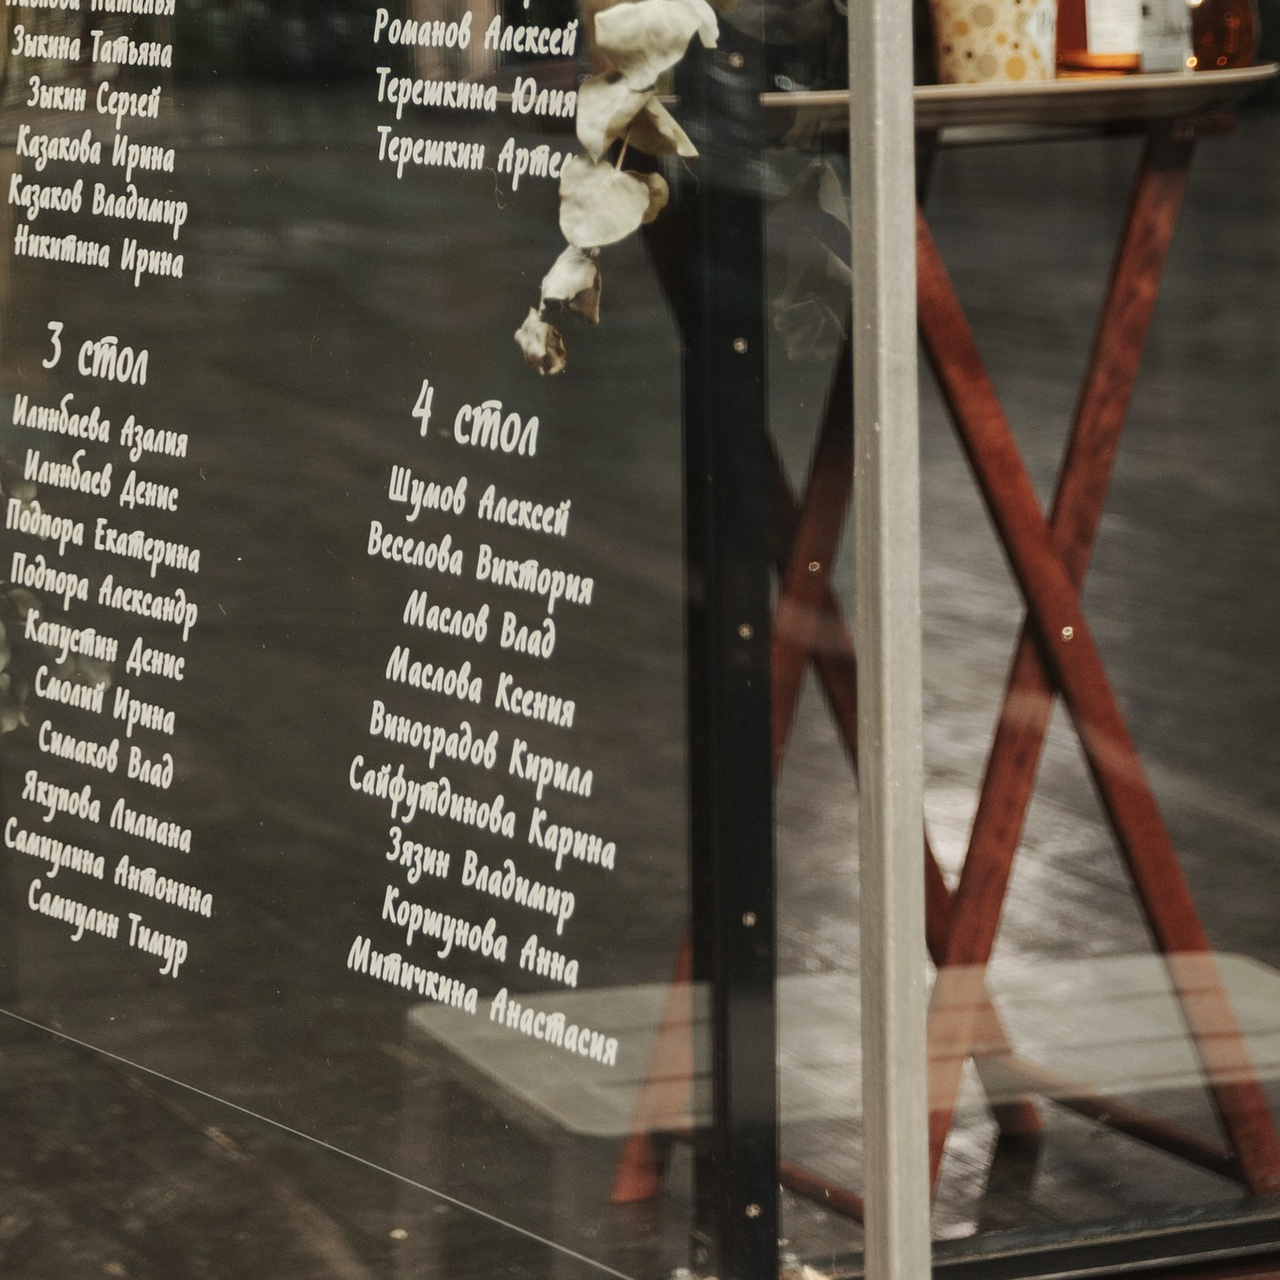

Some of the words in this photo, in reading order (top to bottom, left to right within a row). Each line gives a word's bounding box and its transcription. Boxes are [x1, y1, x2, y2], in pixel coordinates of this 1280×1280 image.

[12, 24, 81, 61] Зыкина
[91, 30, 172, 68] Татьяна
[374, 7, 472, 49] Романов
[484, 14, 578, 56] Алексей
[27, 75, 87, 111] Зыкин
[96, 81, 161, 130] Сергей
[376, 67, 498, 120] Терешкина
[511, 76, 577, 117] Юлия
[16, 124, 101, 171] Казакова
[112, 134, 175, 182] Ирина
[377, 125, 485, 179] Терешкин
[8, 173, 83, 220] Казаков
[92, 179, 188, 241] Владимир
[14, 224, 110, 268] Никитина
[121, 238, 184, 287] Ирина
[42, 321, 64, 369] 3
[78, 336, 149, 386] стол
[12, 393, 110, 443] Илинбаева
[121, 415, 188, 463] Азалия
[412, 379, 434, 437] 4
[454, 400, 540, 457] стол
[24, 449, 112, 497] Илинбаев
[120, 470, 179, 512] Денис
[389, 465, 468, 522] Шумов
[478, 484, 571, 537] Алексей
[6, 498, 84, 557] Подпора
[94, 518, 201, 578] Екатерина
[368, 520, 463, 576] Веселова
[476, 544, 594, 615] Виктория
[11, 552, 89, 611] Подпора
[98, 575, 198, 642] Александр
[403, 590, 489, 642] Маслов
[500, 612, 555, 658] Влад
[24, 610, 118, 664] Капустин
[126, 637, 185, 681] Денис
[35, 665, 105, 714] Смолий
[113, 686, 175, 738] Ирина
[385, 646, 483, 704] Маслова
[495, 672, 575, 722] Ксения
[38, 720, 119, 773] Симаков
[128, 746, 174, 789] Влад
[369, 700, 499, 769] Виноградов
[509, 738, 593, 801] Кирилл
[22, 770, 101, 822] Якупова
[110, 798, 192, 853] Лилиана
[349, 755, 516, 839] Сайфутдинова
[528, 807, 616, 871] Карина
[4, 817, 105, 879] Самиулина
[114, 855, 213, 918] Антонина
[386, 826, 450, 884] Зязин
[461, 850, 575, 935] Владимир
[28, 879, 119, 941] Самиулин
[128, 912, 188, 978] Тимур
[382, 885, 508, 959] Коршунова
[519, 934, 579, 988] Анна
[347, 935, 478, 1014] Митичкина
[490, 988, 618, 1066] Анастасия
